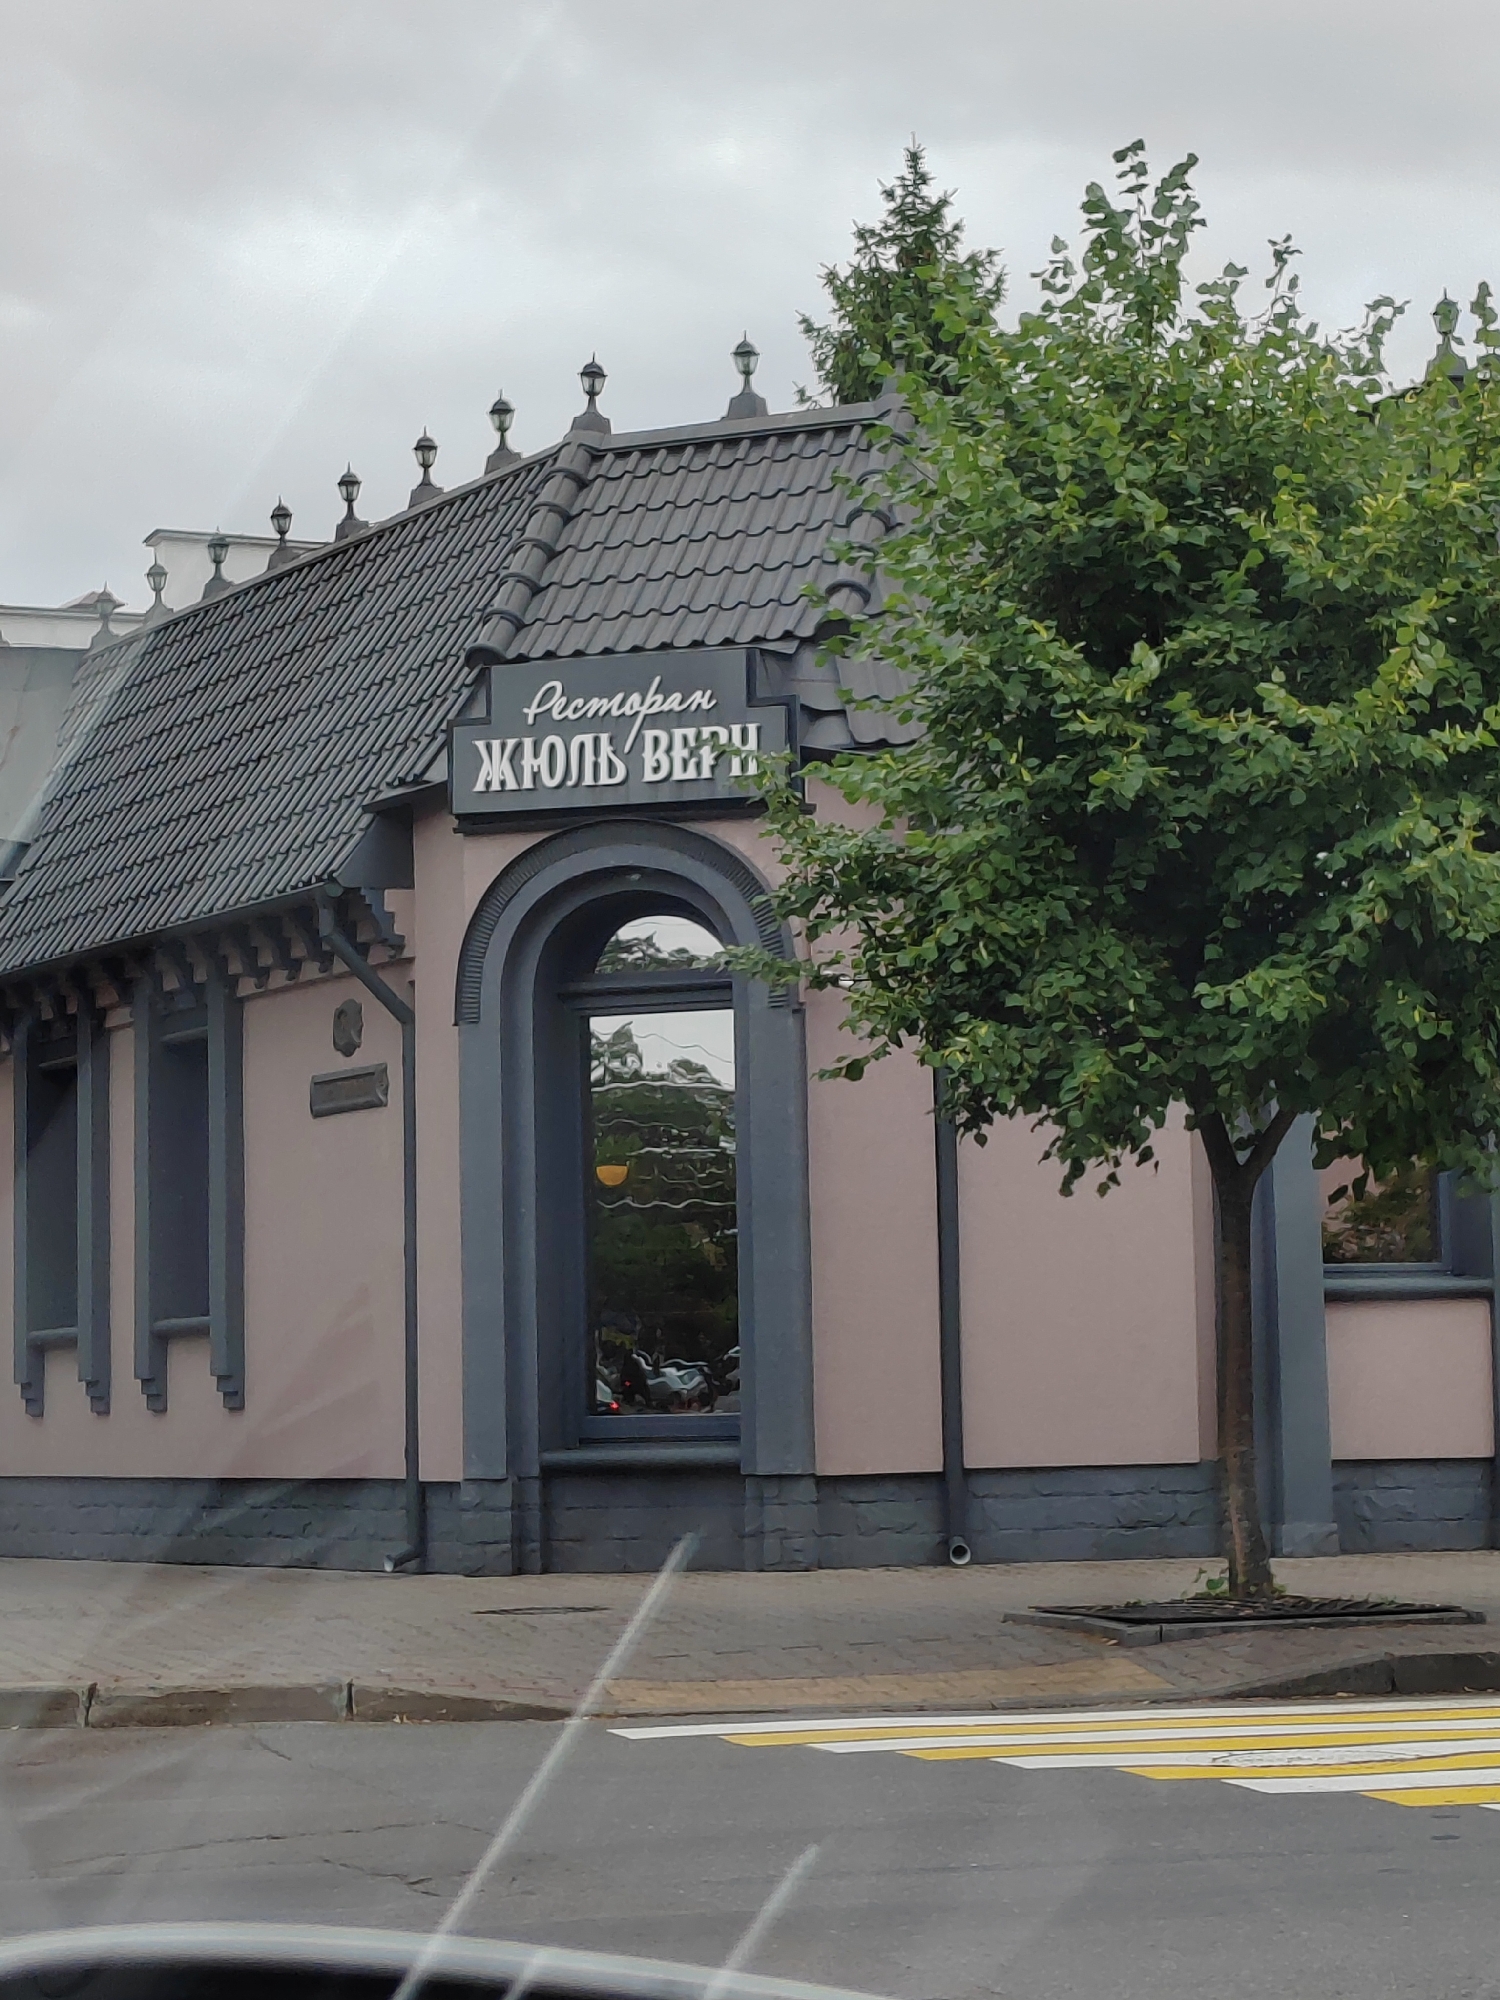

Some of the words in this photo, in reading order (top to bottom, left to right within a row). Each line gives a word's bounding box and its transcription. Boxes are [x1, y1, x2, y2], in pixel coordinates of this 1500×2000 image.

[523, 675, 717, 754] Ресторан
[472, 732, 628, 793] ЖЮЛЬ
[641, 723, 761, 783] ВЕРН
